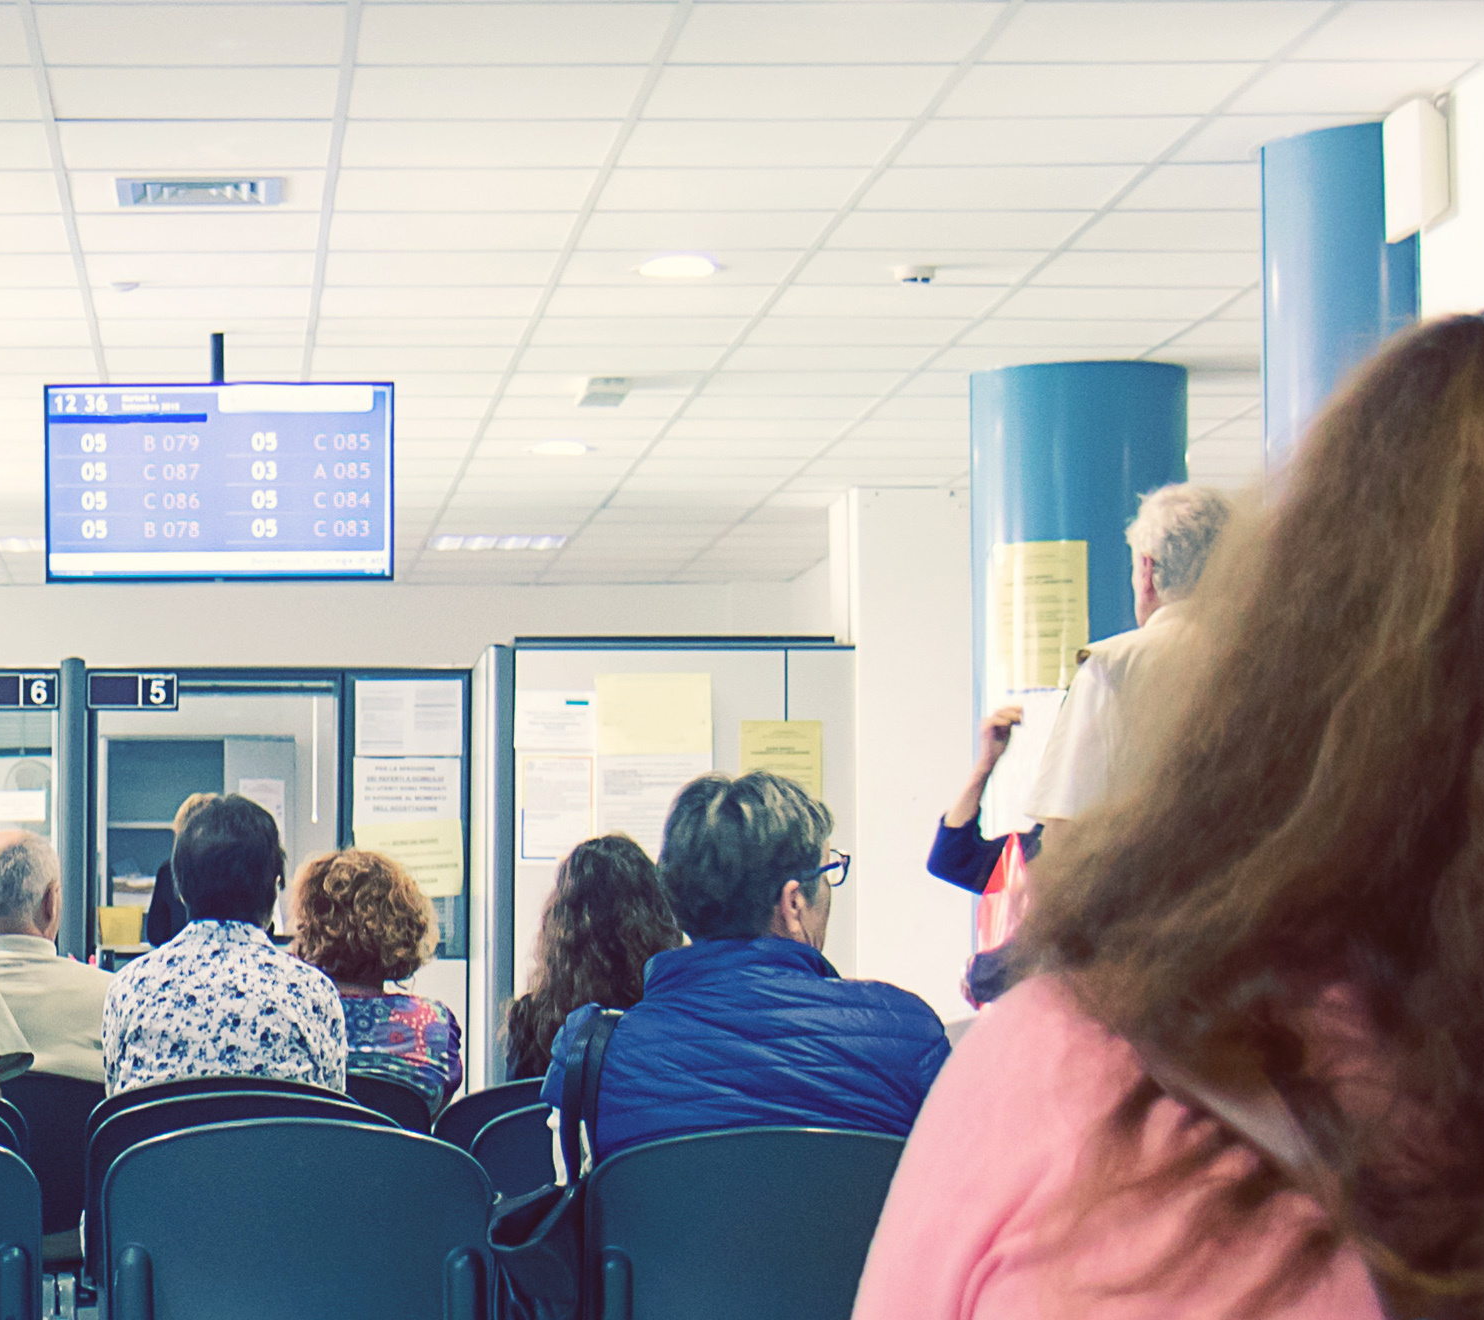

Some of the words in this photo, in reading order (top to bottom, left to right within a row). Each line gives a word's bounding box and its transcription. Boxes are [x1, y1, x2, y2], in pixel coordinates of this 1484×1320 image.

[54, 394, 77, 413] 12
[84, 394, 108, 413] 36
[80, 433, 107, 453] 05
[144, 434, 156, 452] B
[162, 434, 200, 452] 079
[251, 432, 278, 452] 05
[313, 433, 327, 451] C
[333, 433, 371, 451] 085
[80, 462, 107, 482] 05
[144, 464, 156, 480] C
[162, 464, 200, 480] 087
[251, 460, 278, 480] 03
[313, 462, 327, 480] A
[333, 462, 371, 480] 085
[80, 490, 107, 510] 05
[144, 492, 156, 510] C
[162, 492, 200, 510] 086
[251, 490, 278, 510] 05
[313, 491, 327, 508] C
[333, 491, 371, 508] 084
[80, 519, 107, 539] 05
[144, 520, 156, 538] B
[162, 520, 200, 538] 078
[251, 518, 278, 538] 05
[313, 520, 327, 537] C
[333, 520, 371, 537] 083
[30, 680, 48, 705] 6
[149, 680, 167, 705] 5
